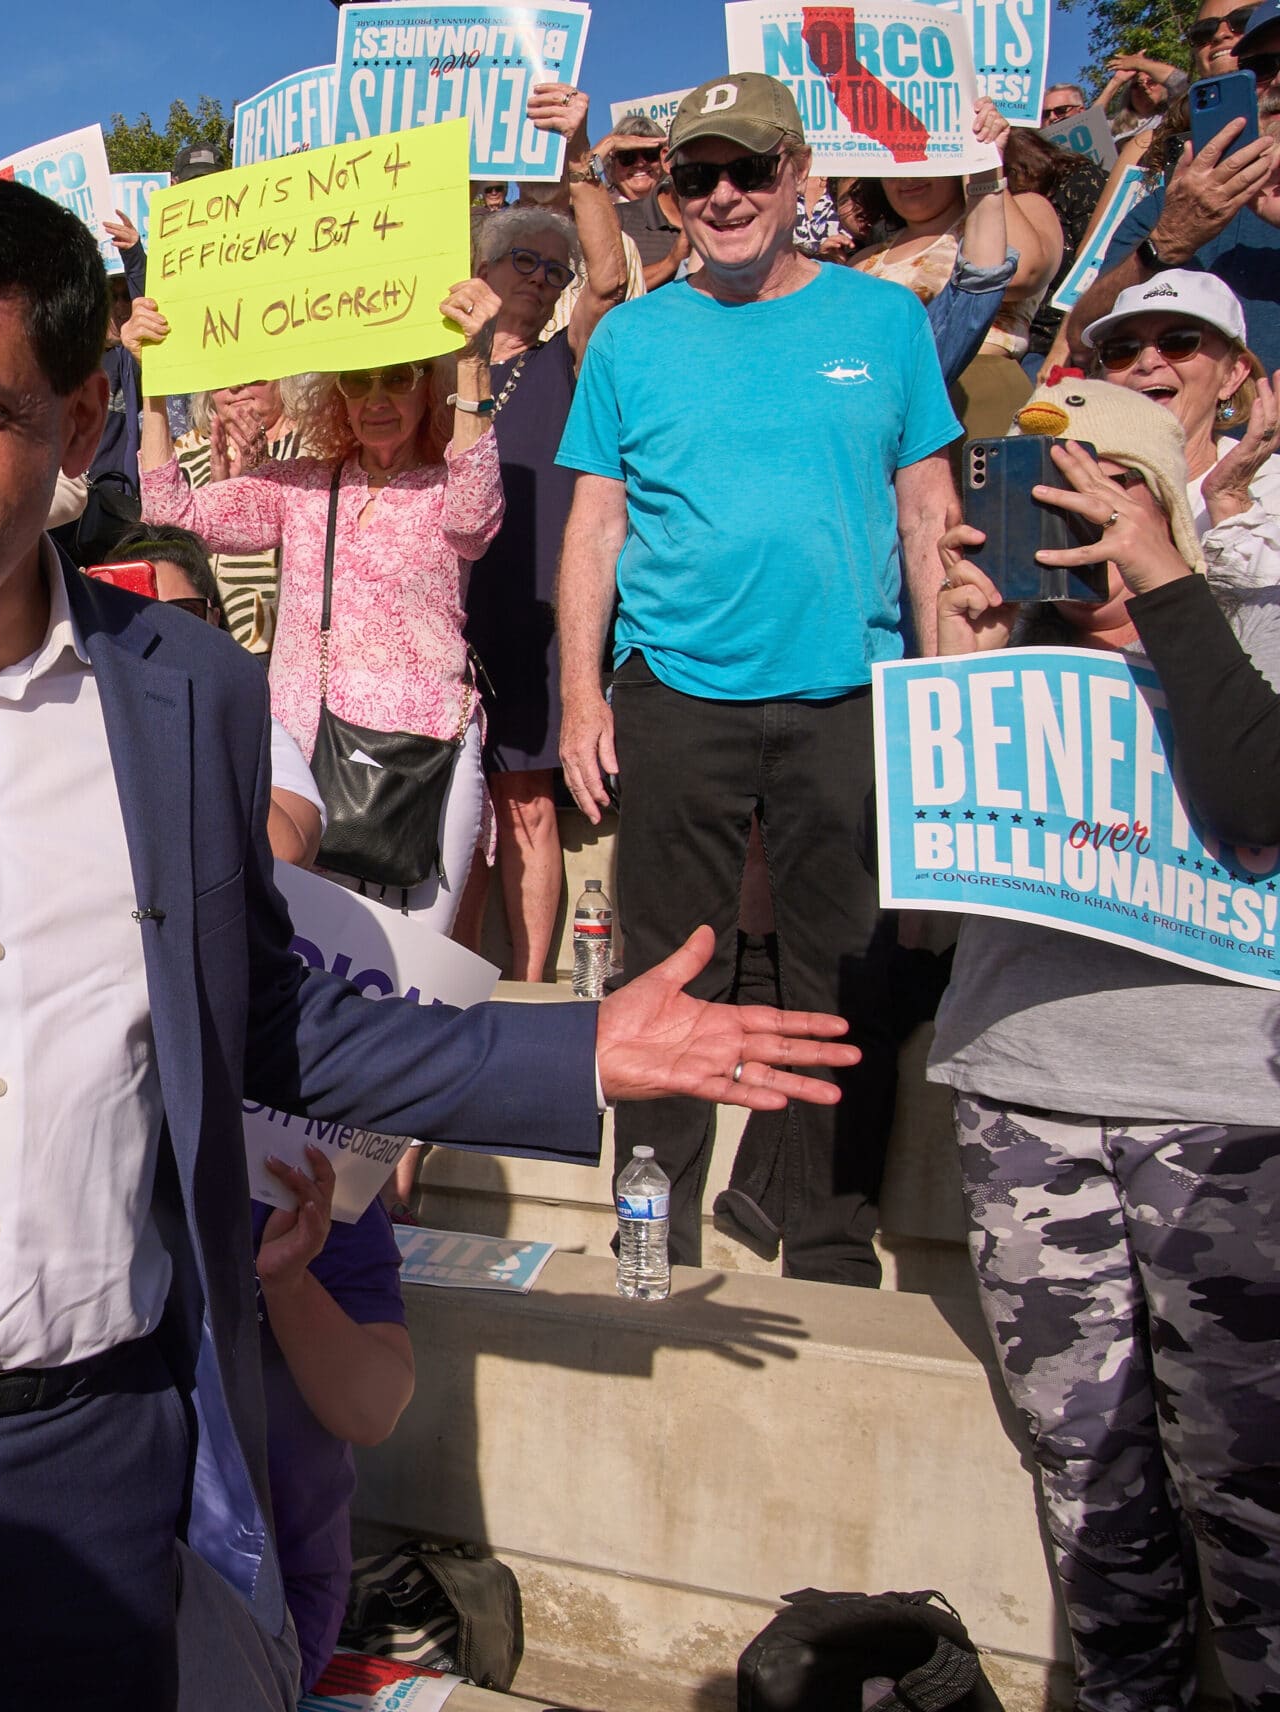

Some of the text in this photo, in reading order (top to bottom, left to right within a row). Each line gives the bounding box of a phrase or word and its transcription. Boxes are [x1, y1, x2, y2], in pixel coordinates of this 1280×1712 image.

[402, 17, 433, 25] PROTECT
[442, 16, 477, 25] KHANNA
[761, 20, 955, 79] NORCO
[240, 76, 337, 167] BENEFI
[700, 83, 738, 114] D
[784, 77, 842, 132] ADY
[848, 80, 878, 132] TO
[887, 81, 962, 133] FIGHT!
[13, 151, 87, 195] RCO
[159, 184, 249, 239] ELON
[383, 141, 412, 190] 4
[373, 204, 405, 242] 4
[1143, 289, 1178, 299] adidas
[202, 297, 243, 349] AN
[907, 669, 1200, 856] BENEF
[1068, 819, 1152, 856] over
[913, 822, 1278, 947] BILLIONAIRES!
[933, 871, 1056, 897] CONGRESSMAN
[1060, 889, 1080, 903] RO
[1084, 895, 1139, 920] KHANNA
[1141, 912, 1150, 924] &
[1152, 915, 1207, 941] PROTECT
[1209, 934, 1235, 951] OUR
[1238, 943, 1276, 960] CARE
